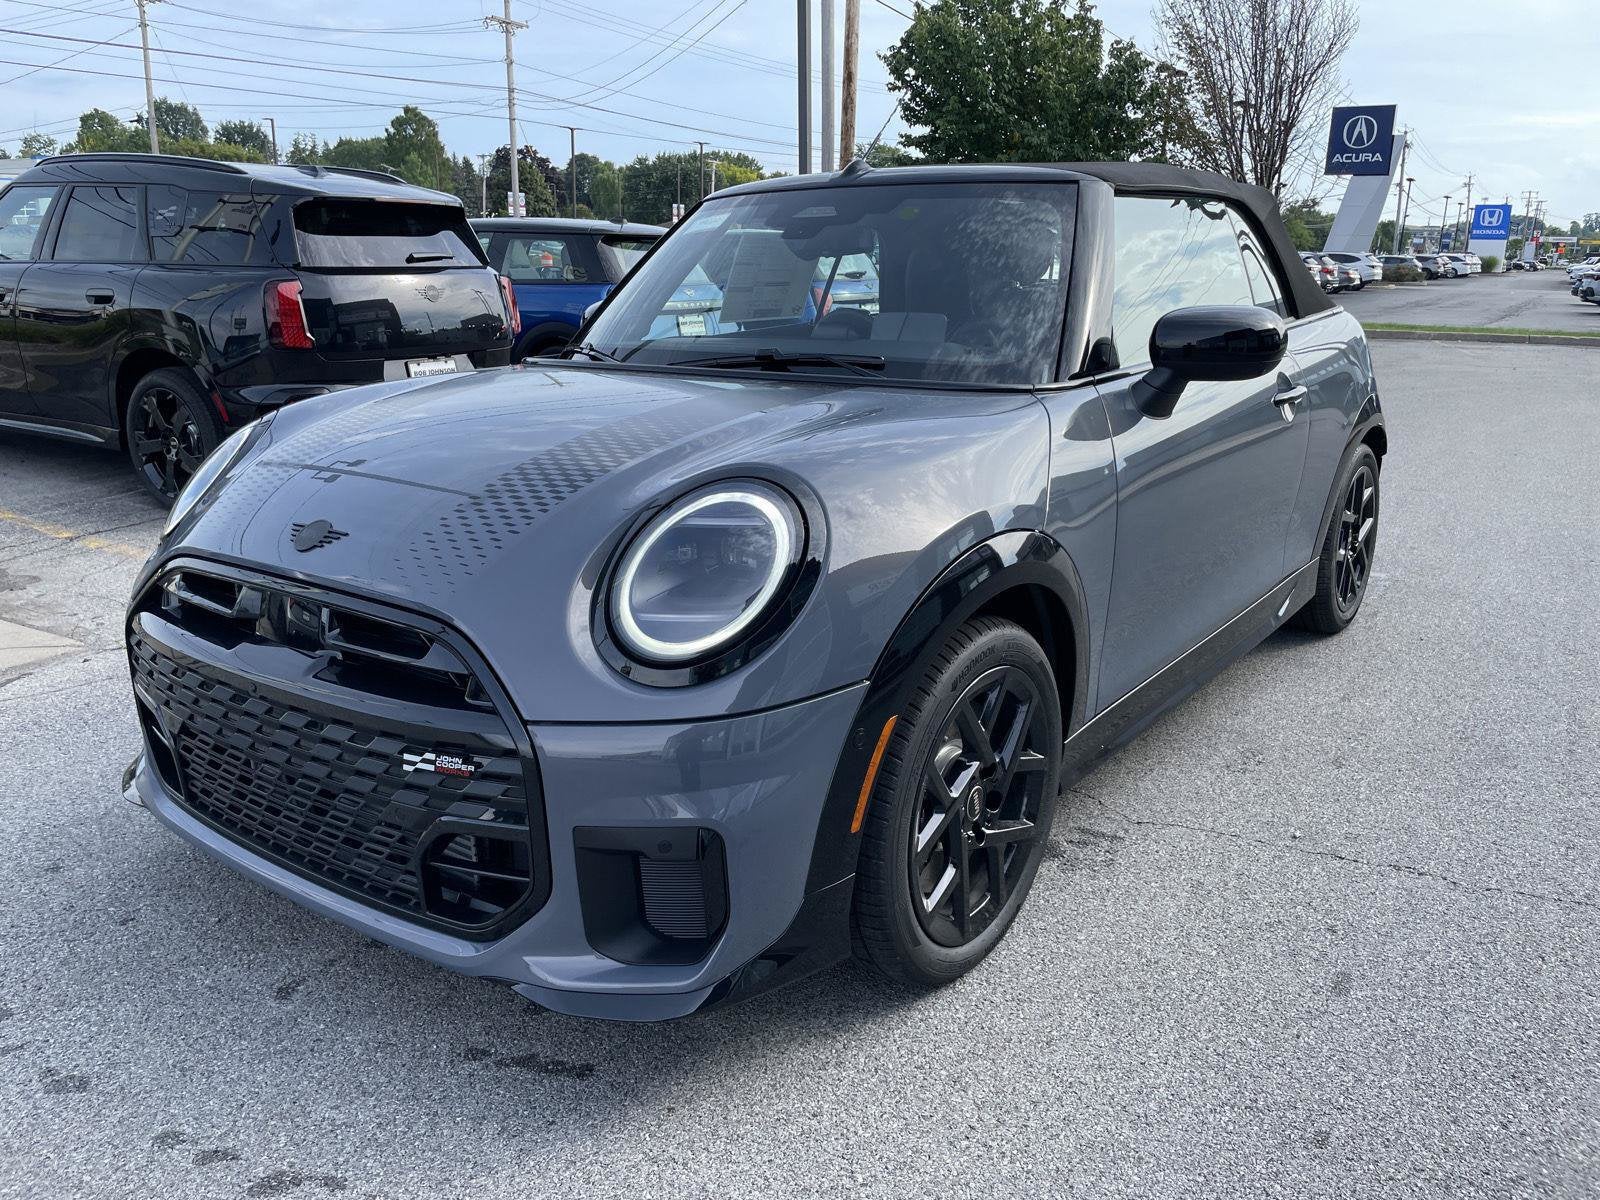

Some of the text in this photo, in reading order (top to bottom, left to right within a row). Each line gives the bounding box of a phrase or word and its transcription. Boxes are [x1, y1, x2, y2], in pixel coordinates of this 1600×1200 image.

[1332, 153, 1382, 163] ACURA
[436, 755, 463, 764] JOHN
[435, 760, 475, 772] COOPER
[436, 766, 471, 777] WORKS
